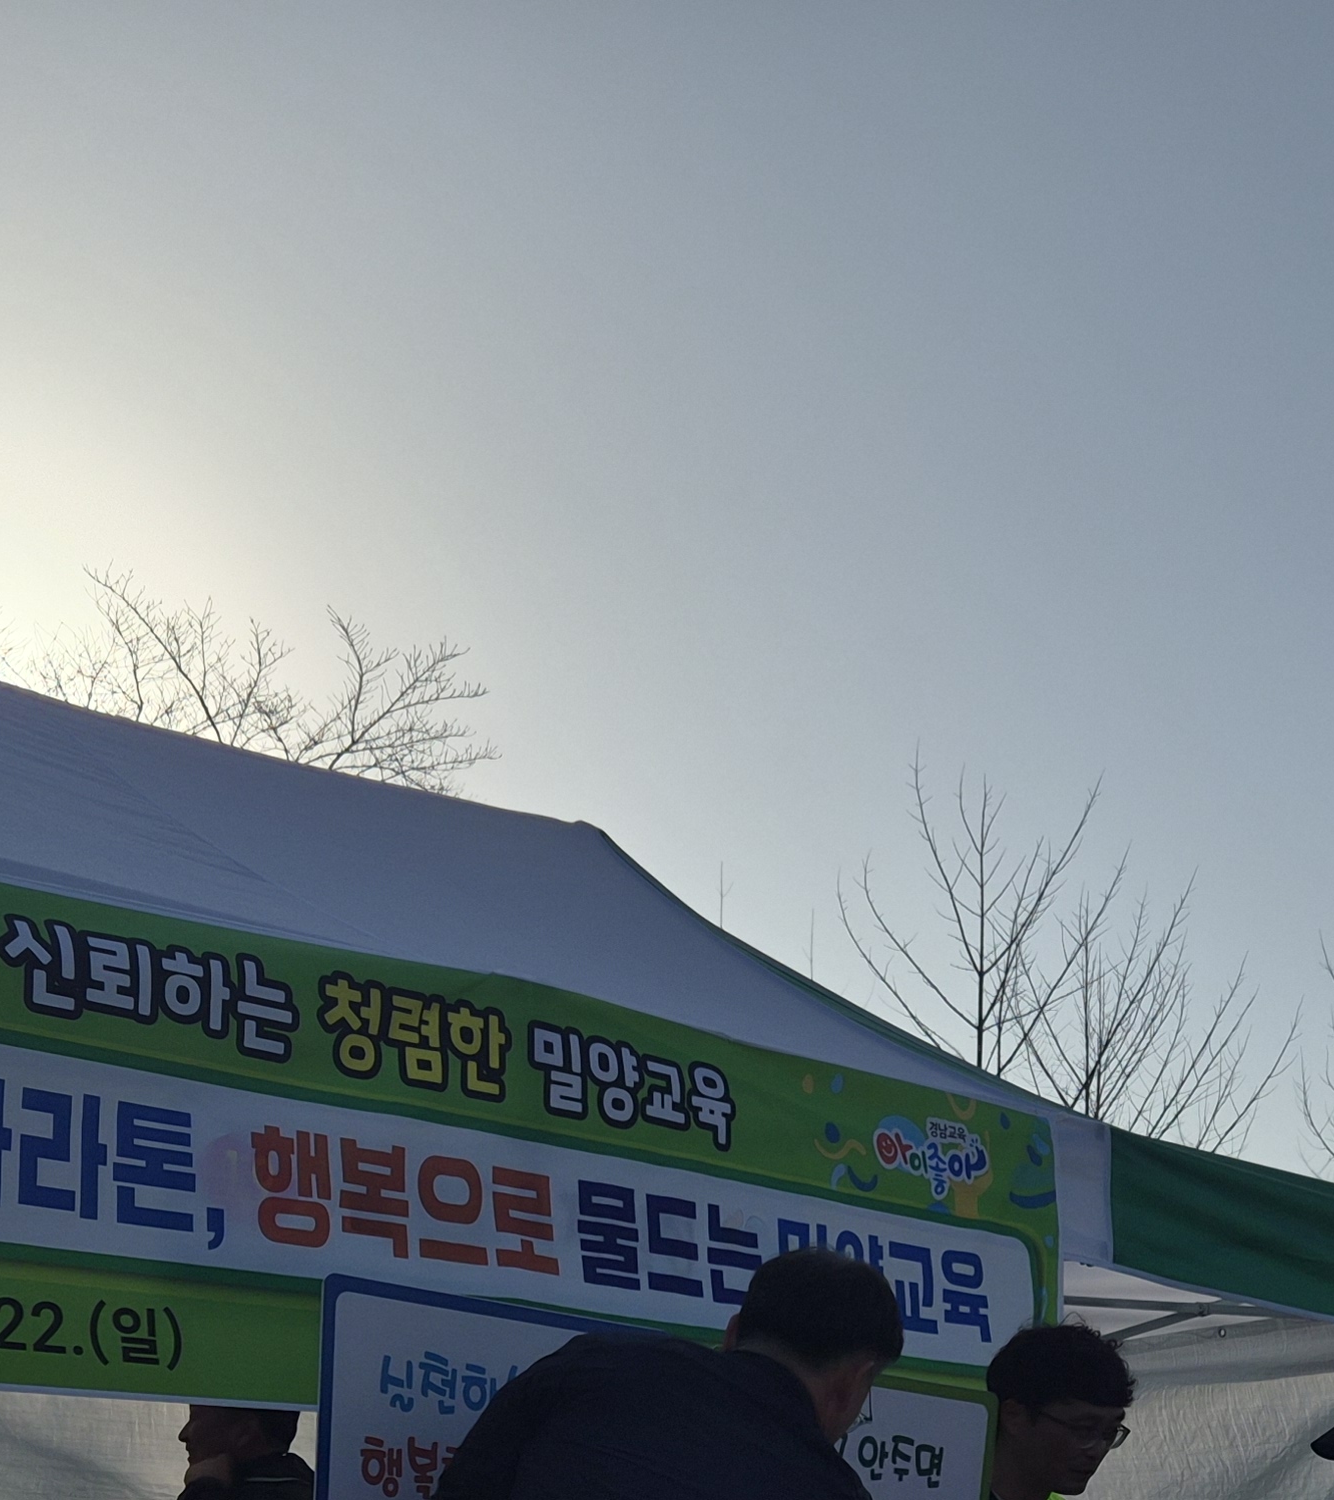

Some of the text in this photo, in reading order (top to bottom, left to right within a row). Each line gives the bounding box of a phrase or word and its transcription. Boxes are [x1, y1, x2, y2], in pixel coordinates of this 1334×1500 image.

[319, 970, 509, 1101] 청렴한
[528, 1020, 735, 1152] 밀양교육
[876, 1132, 987, 1195] 아이좋아
[929, 1121, 967, 1143] 경남교육
[251, 1125, 559, 1275] 행복으로
[578, 1179, 762, 1305] 물드는
[380, 1355, 517, 1415] 실천하
[360, 1436, 458, 1500] 행복
[858, 1435, 944, 1488] 안주면
